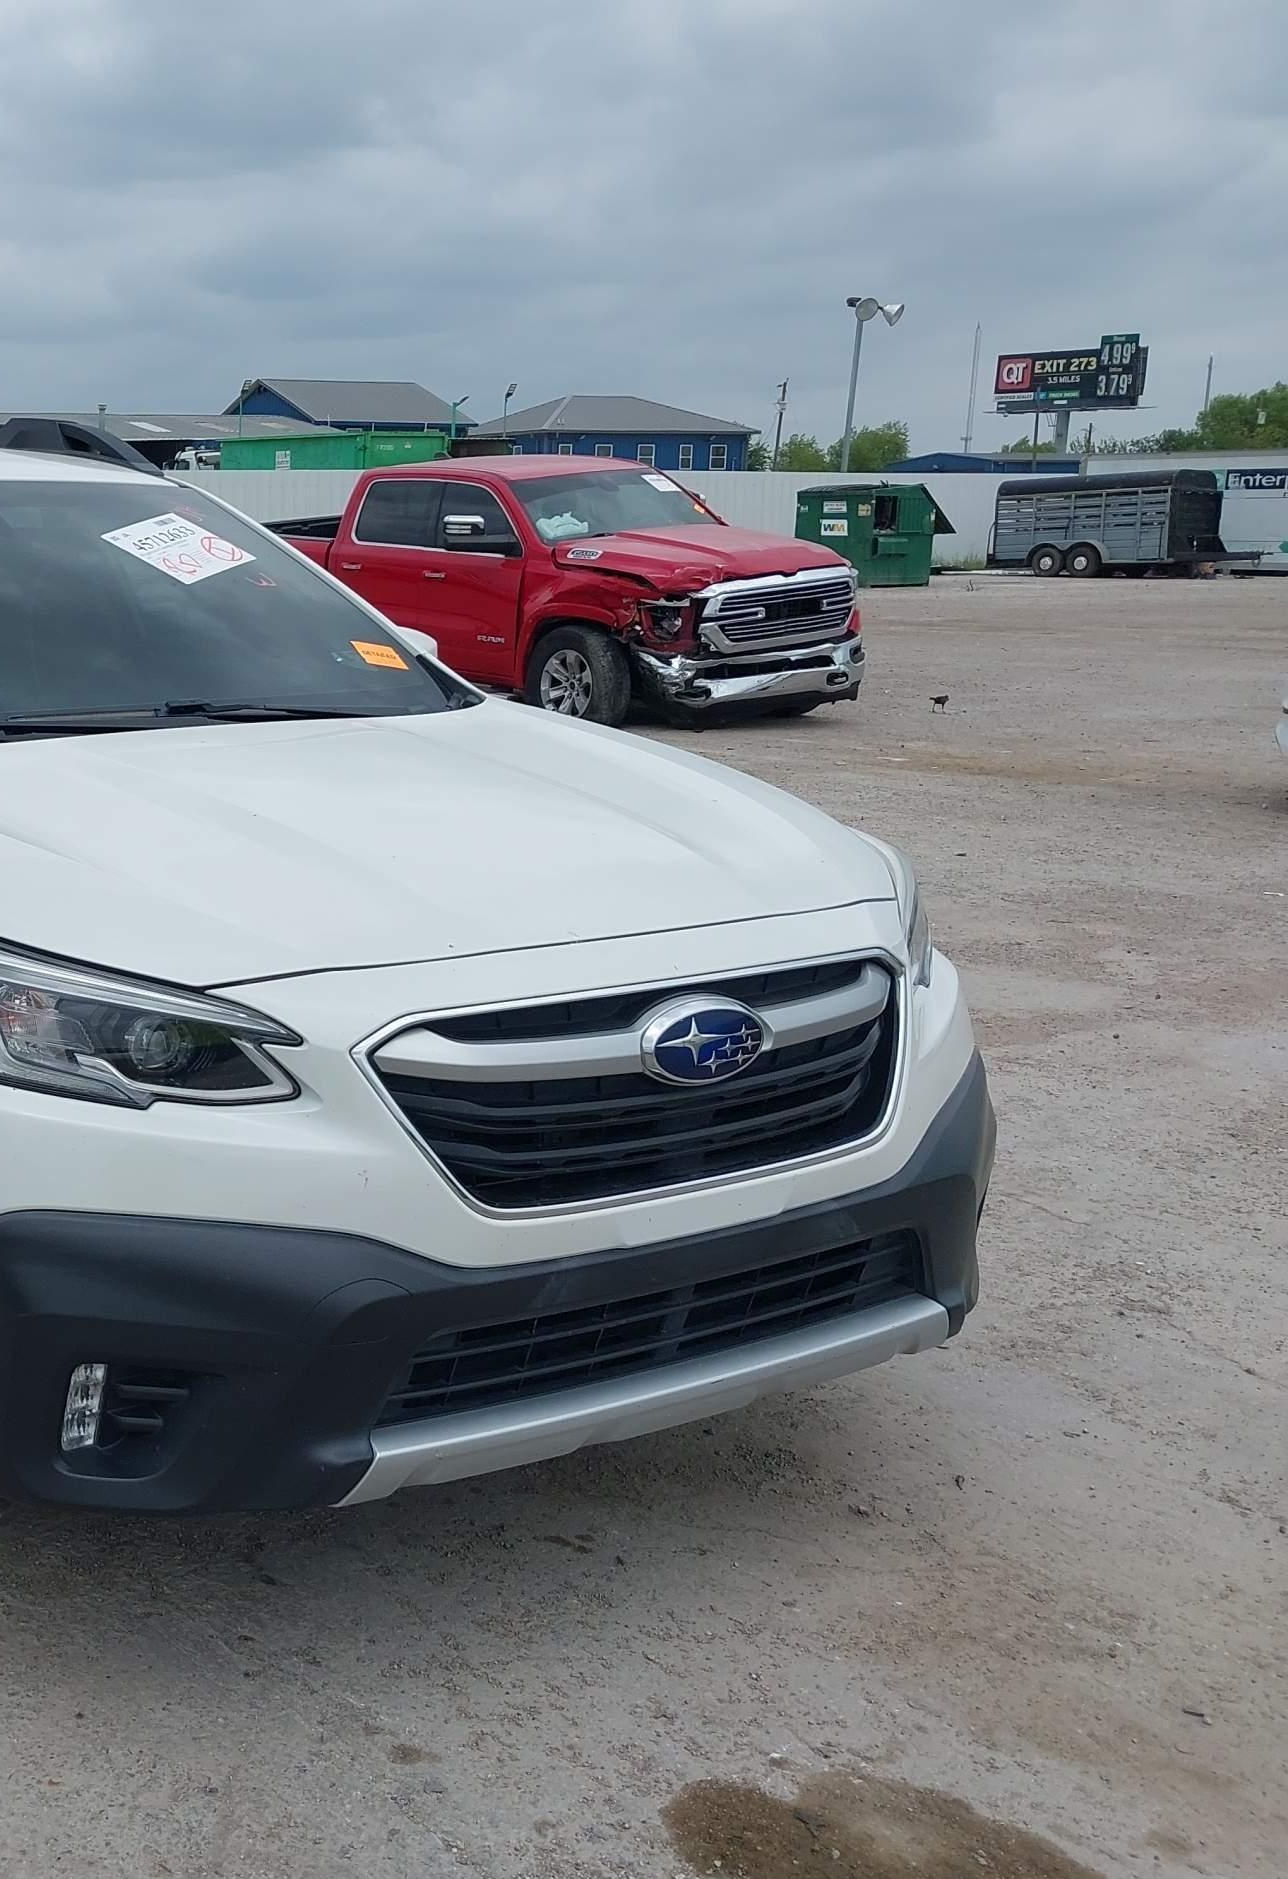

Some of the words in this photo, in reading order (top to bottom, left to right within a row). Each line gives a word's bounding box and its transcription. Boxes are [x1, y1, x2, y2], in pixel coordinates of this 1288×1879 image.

[1002, 362, 1027, 385] QT
[1034, 359, 1067, 373] EXIT
[1070, 356, 1097, 371] 273
[1058, 375, 1081, 384] MILES
[132, 525, 196, 551] 45712633
